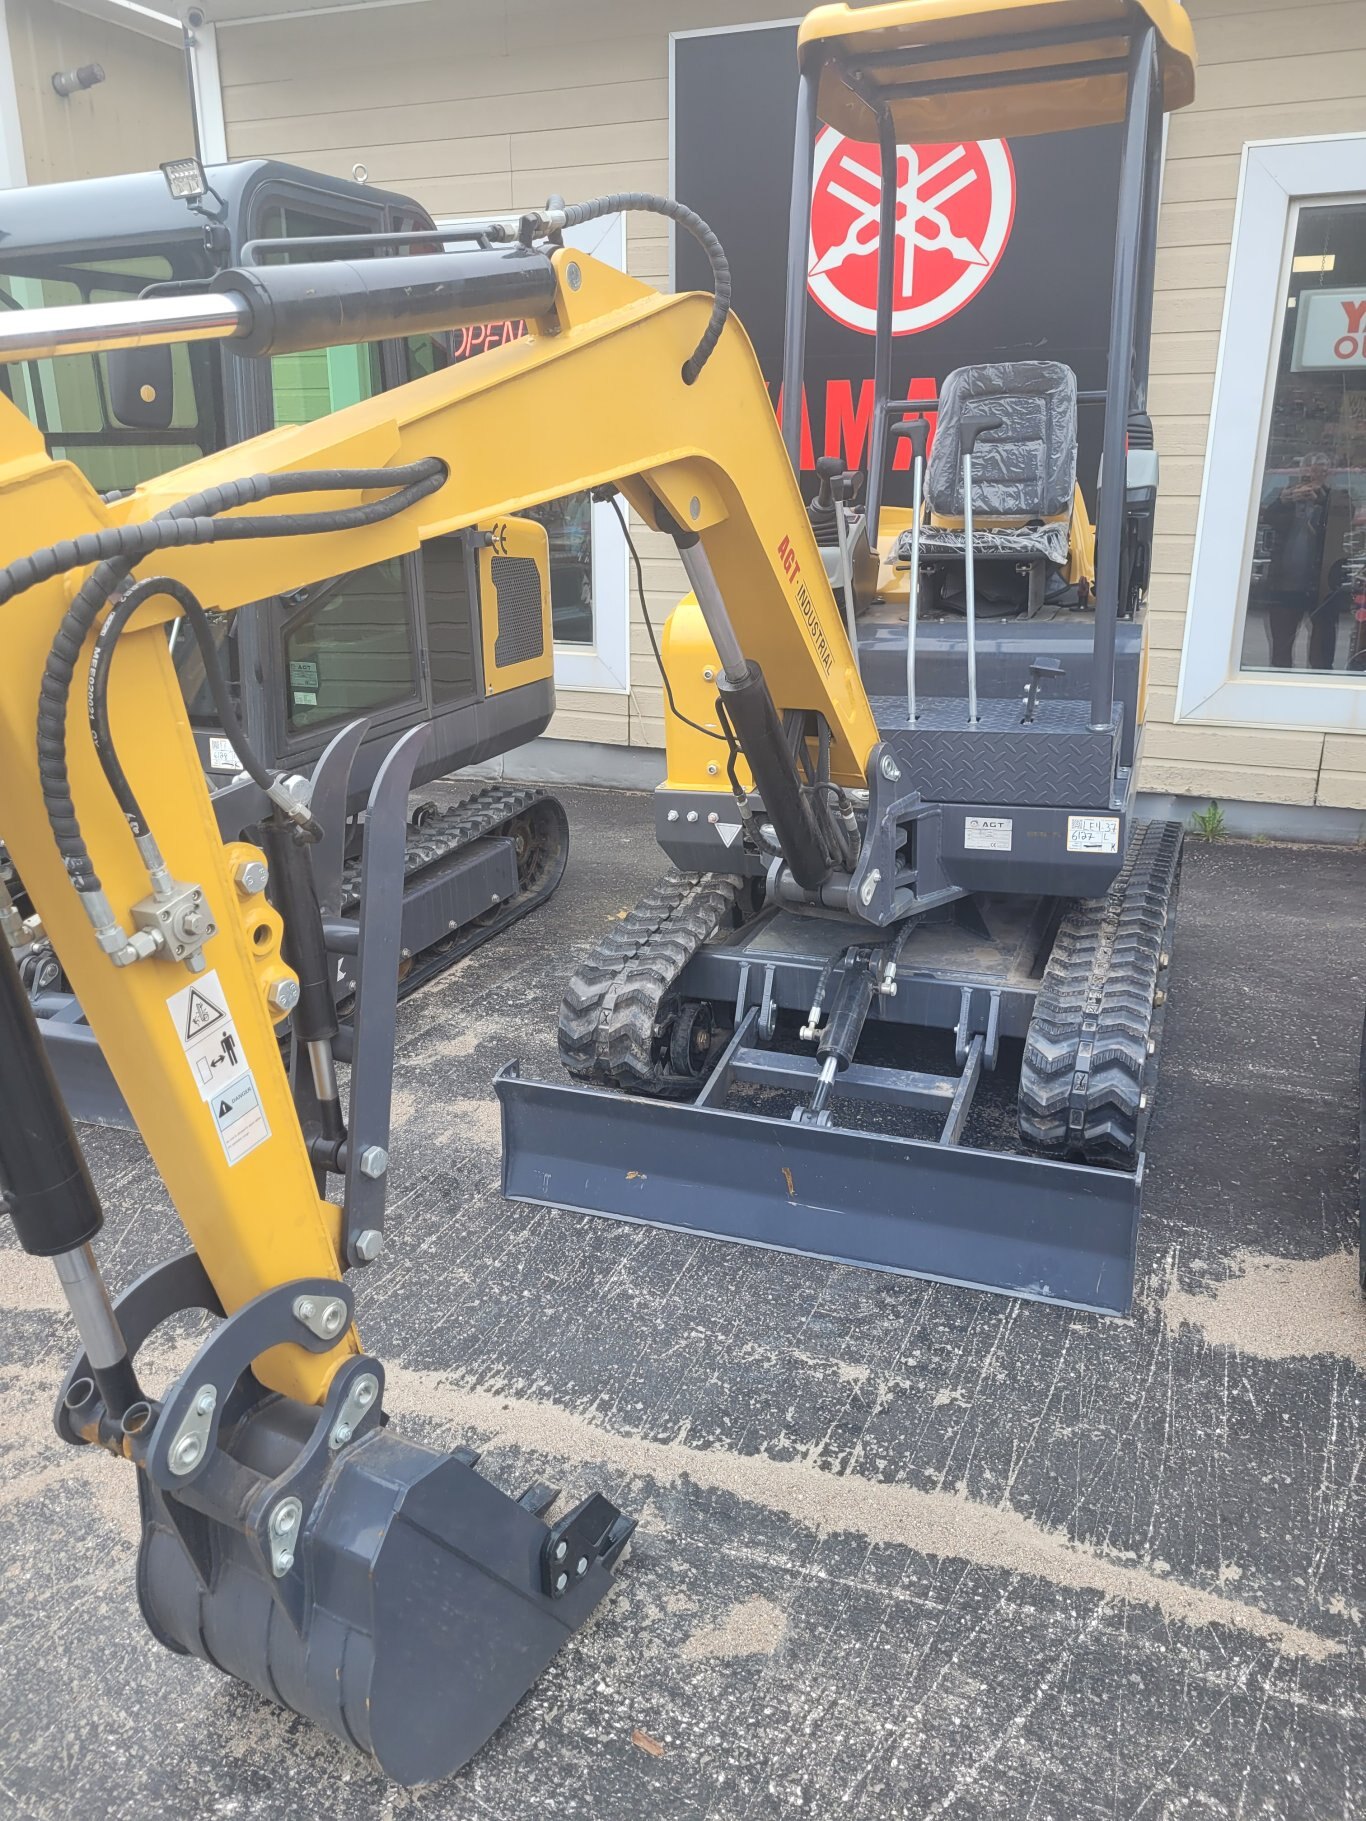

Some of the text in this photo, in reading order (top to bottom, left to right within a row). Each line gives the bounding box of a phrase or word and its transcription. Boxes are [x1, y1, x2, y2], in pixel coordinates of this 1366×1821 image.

[1340, 300, 1366, 334] Y
[778, 534, 834, 676] AGT INDUSTRIAL
[231, 1086, 252, 1105] DANGER
